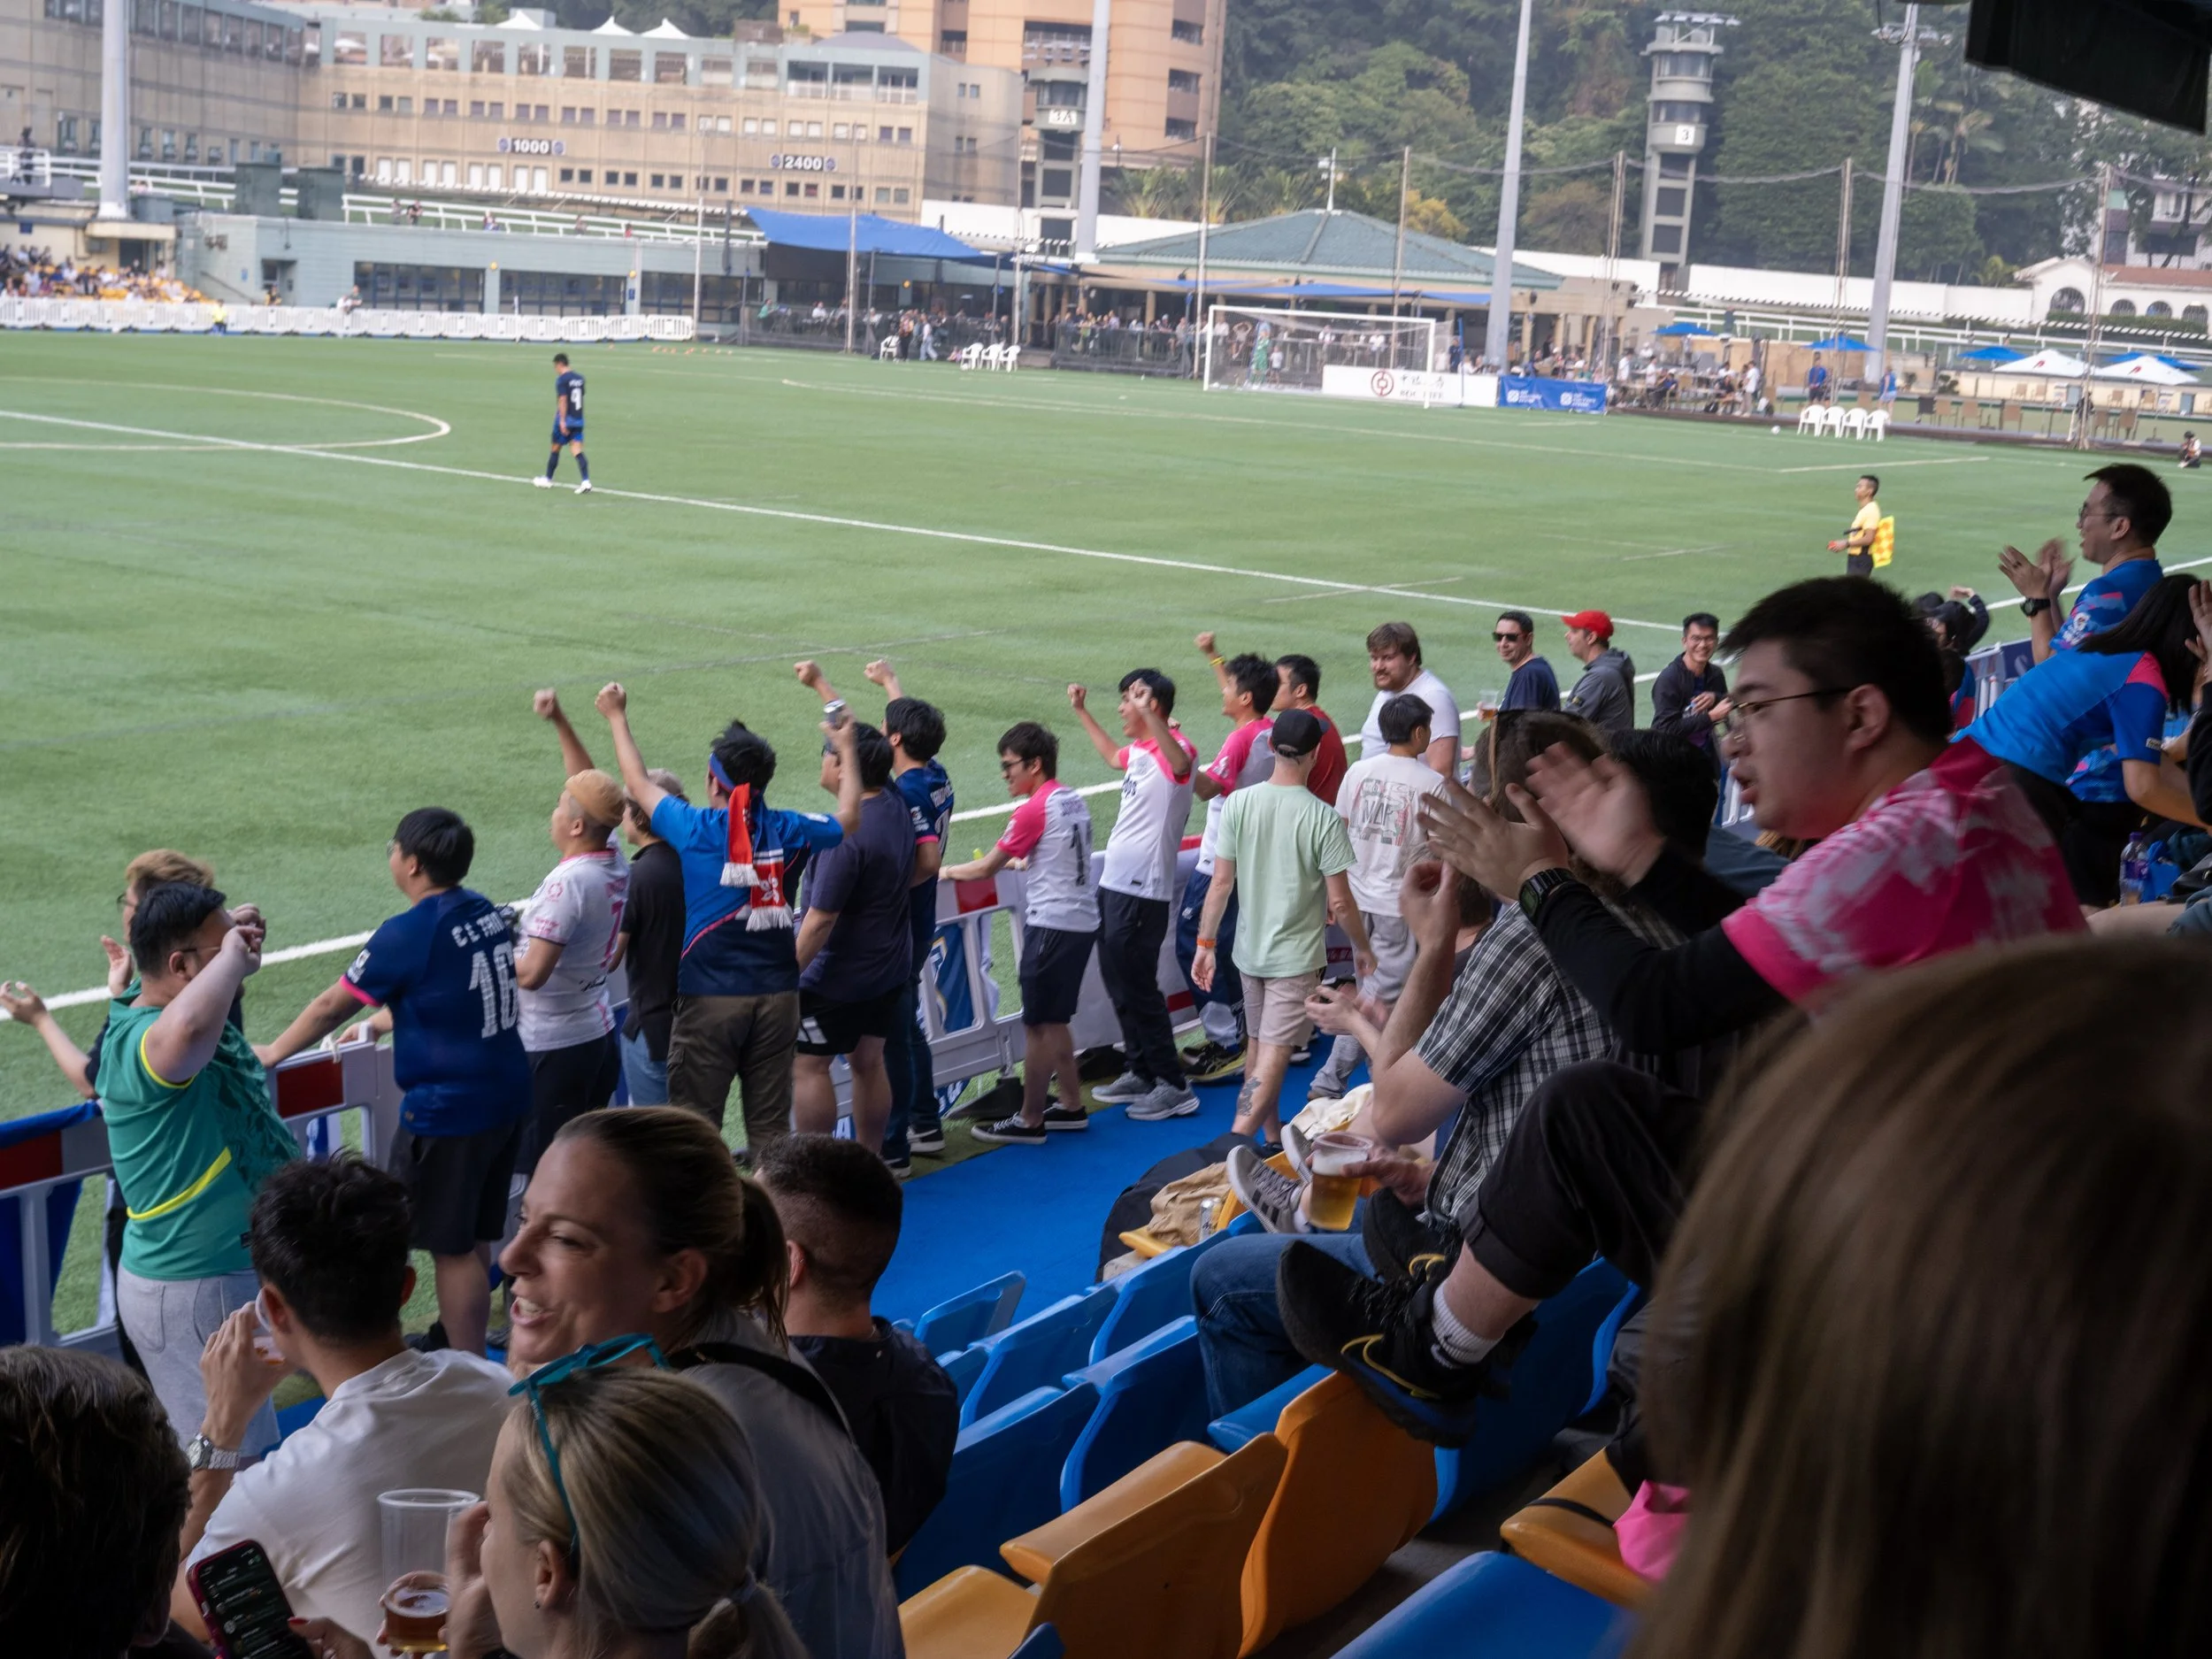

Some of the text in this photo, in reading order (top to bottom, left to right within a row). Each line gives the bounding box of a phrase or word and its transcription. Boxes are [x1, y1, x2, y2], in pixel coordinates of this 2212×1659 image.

[513, 138, 549, 154] 1000
[784, 155, 823, 171] 2400
[571, 388, 582, 411] 9
[468, 941, 518, 1040] 16
